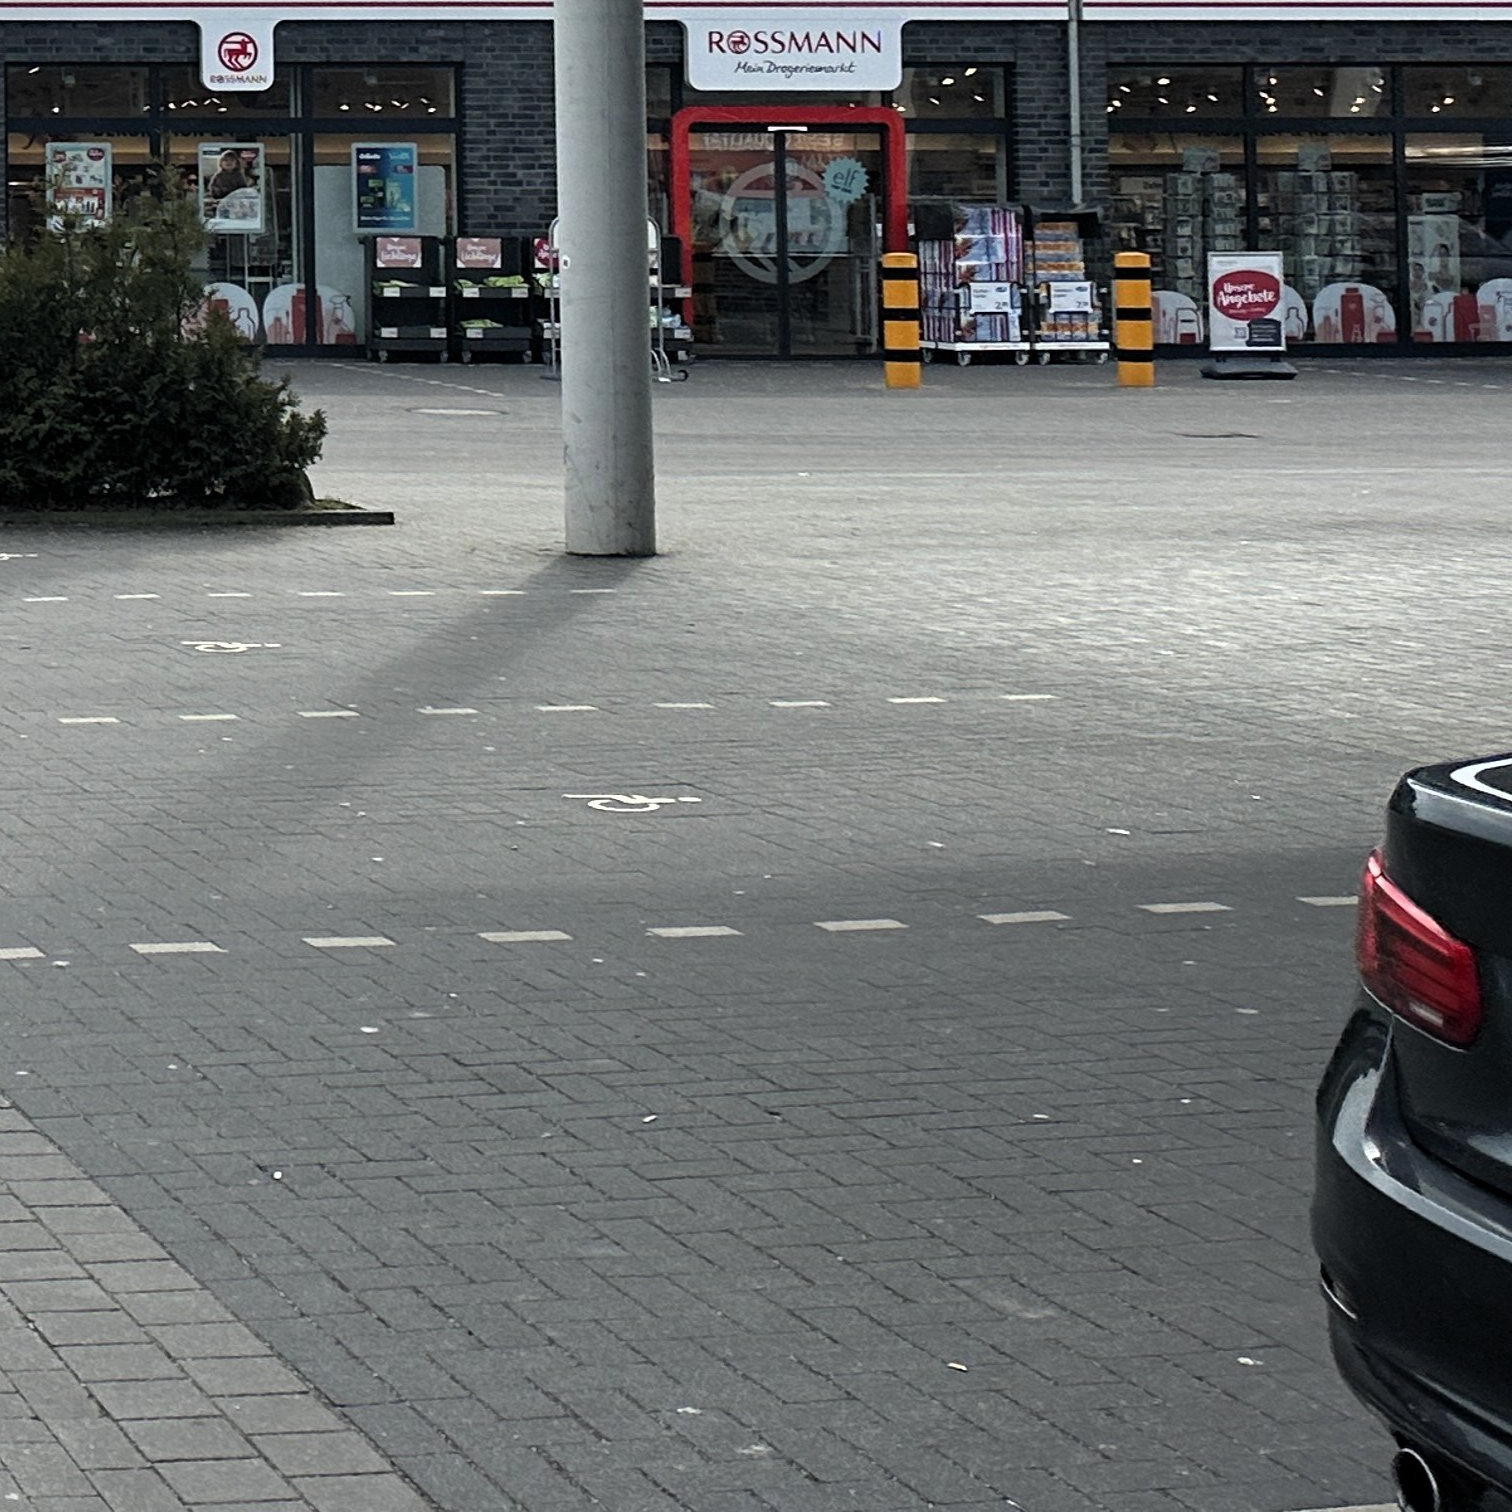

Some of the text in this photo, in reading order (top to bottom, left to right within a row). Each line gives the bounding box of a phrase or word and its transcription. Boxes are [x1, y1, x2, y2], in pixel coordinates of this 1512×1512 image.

[708, 30, 882, 54] ROSSMANN
[734, 60, 858, 79] Mein Drogeriemarkt
[1223, 282, 1255, 294] Unsere
[1217, 289, 1276, 308] Angebote
